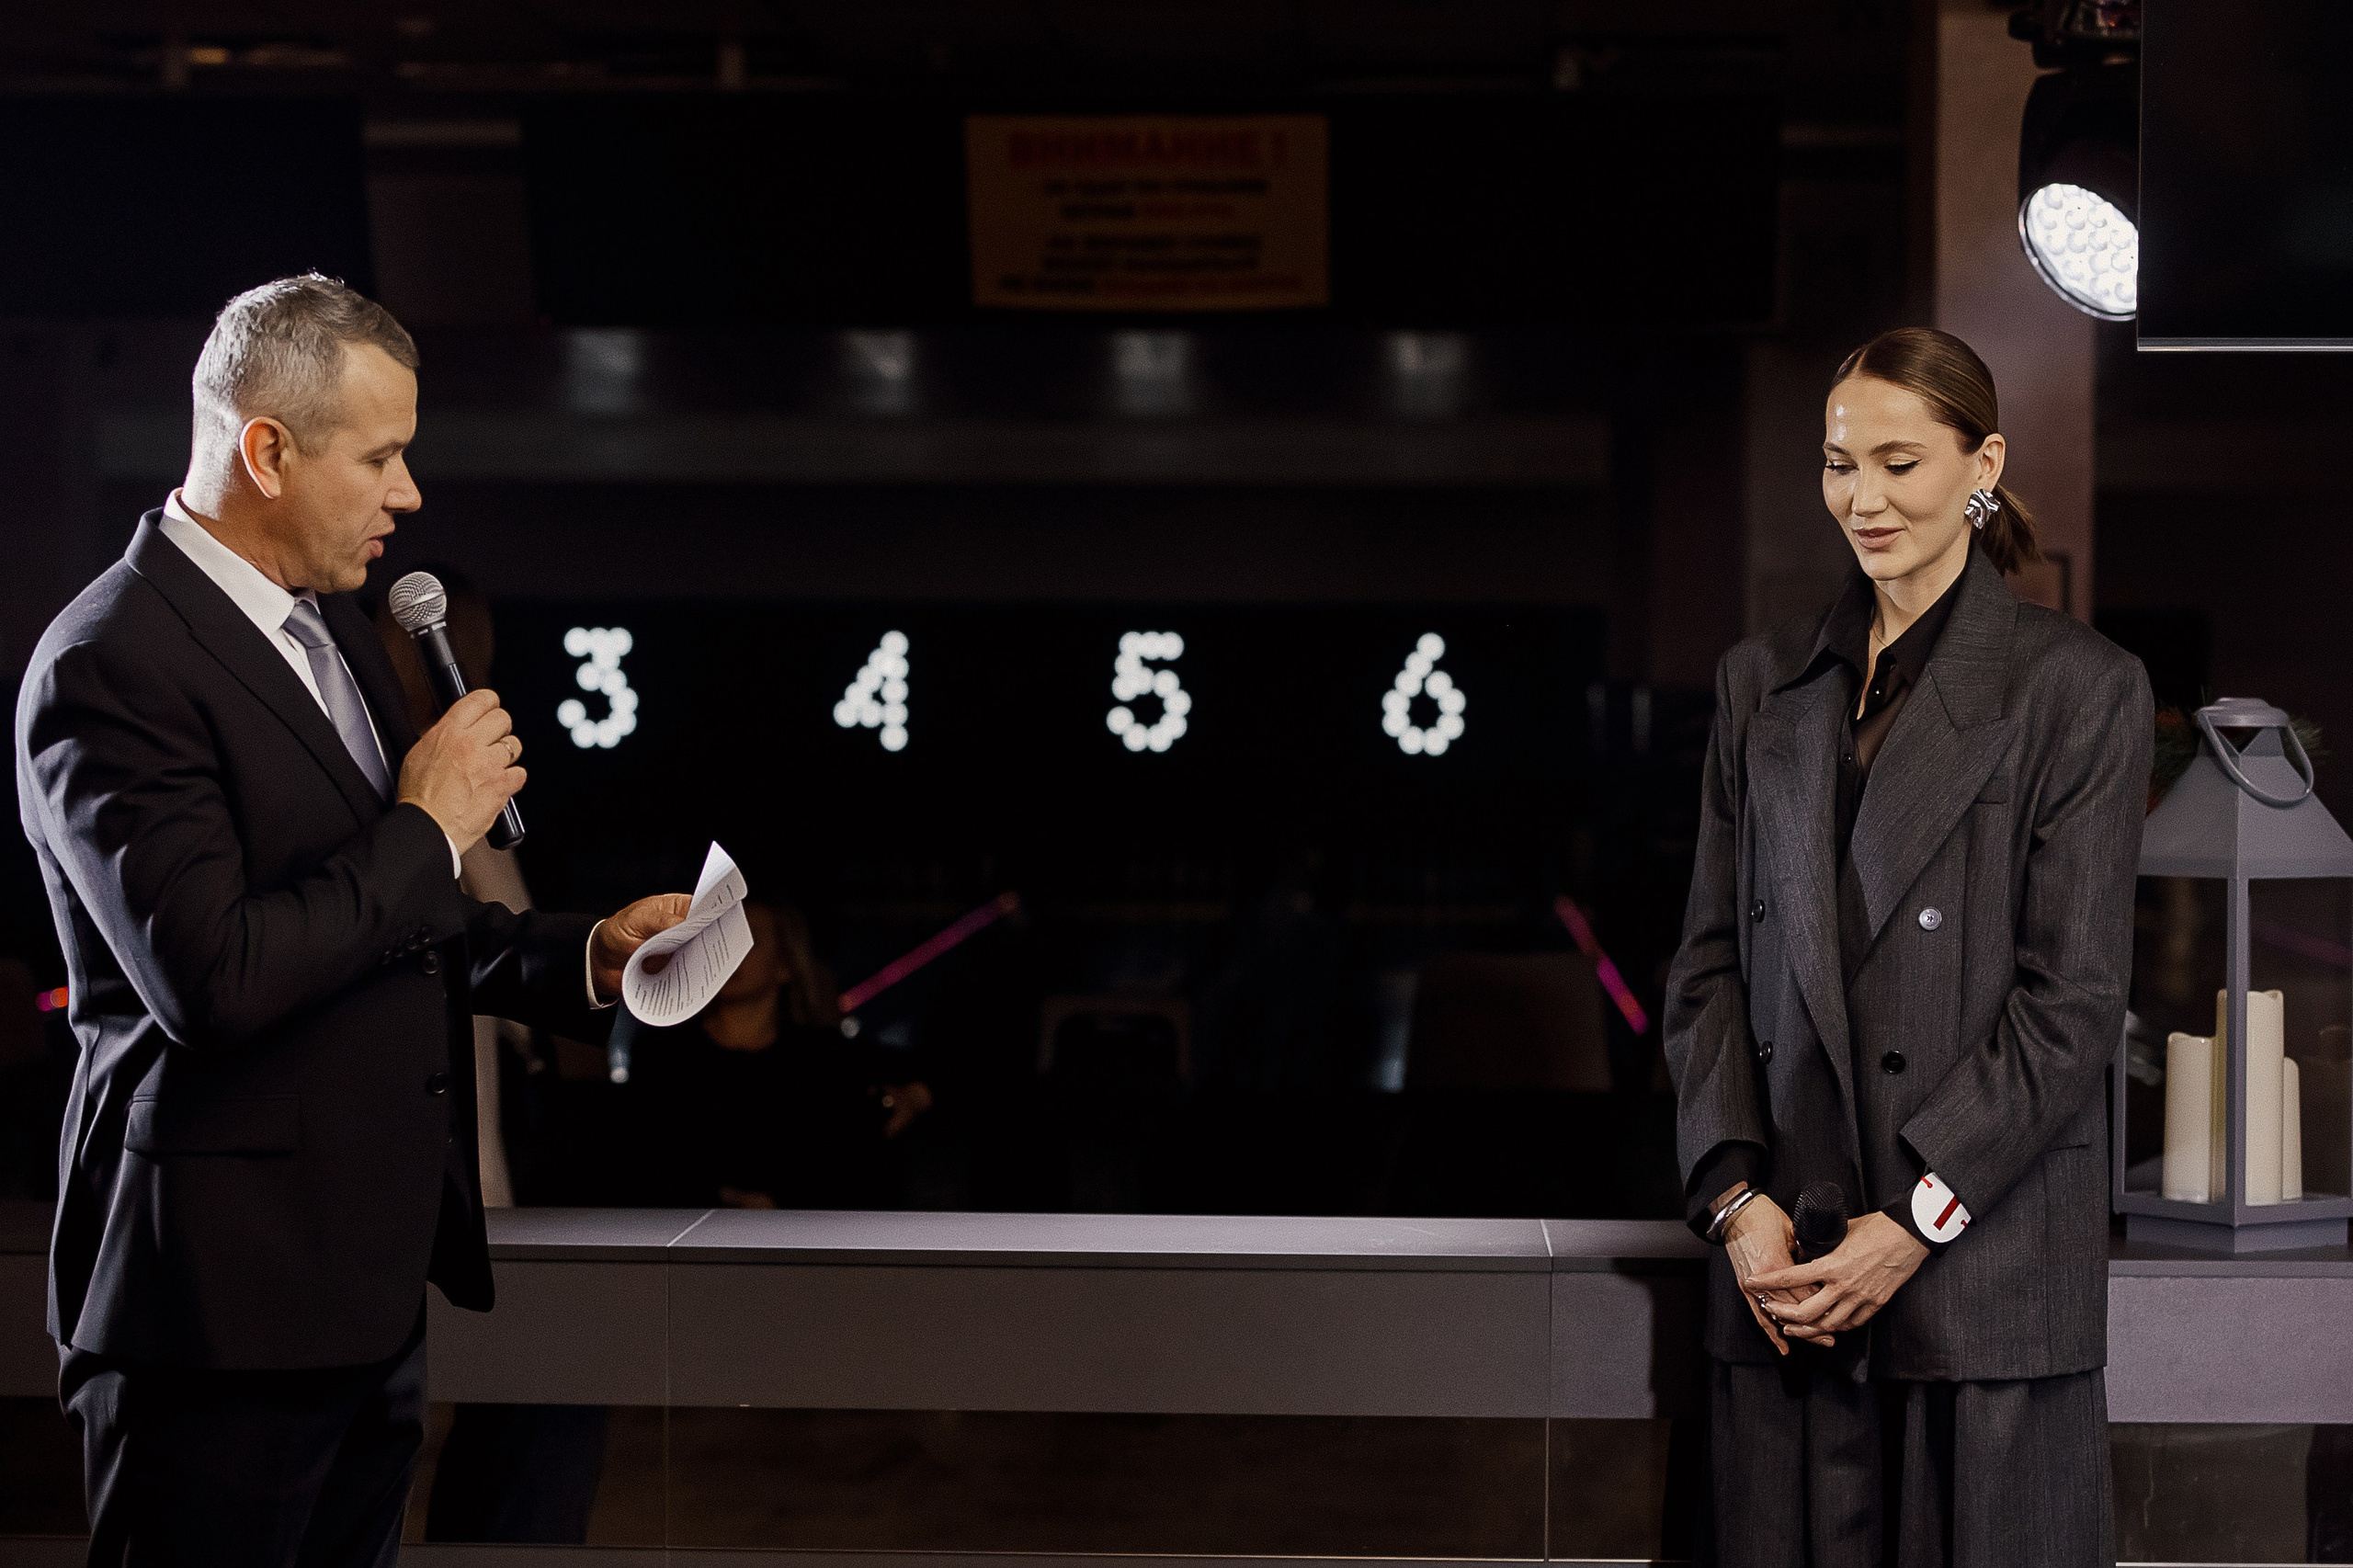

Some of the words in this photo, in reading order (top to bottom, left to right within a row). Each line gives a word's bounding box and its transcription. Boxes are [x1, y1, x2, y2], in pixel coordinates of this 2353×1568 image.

[557, 628, 637, 747] 3
[834, 631, 908, 750] 4
[1107, 631, 1190, 751] 5
[1382, 632, 1465, 755] 6
